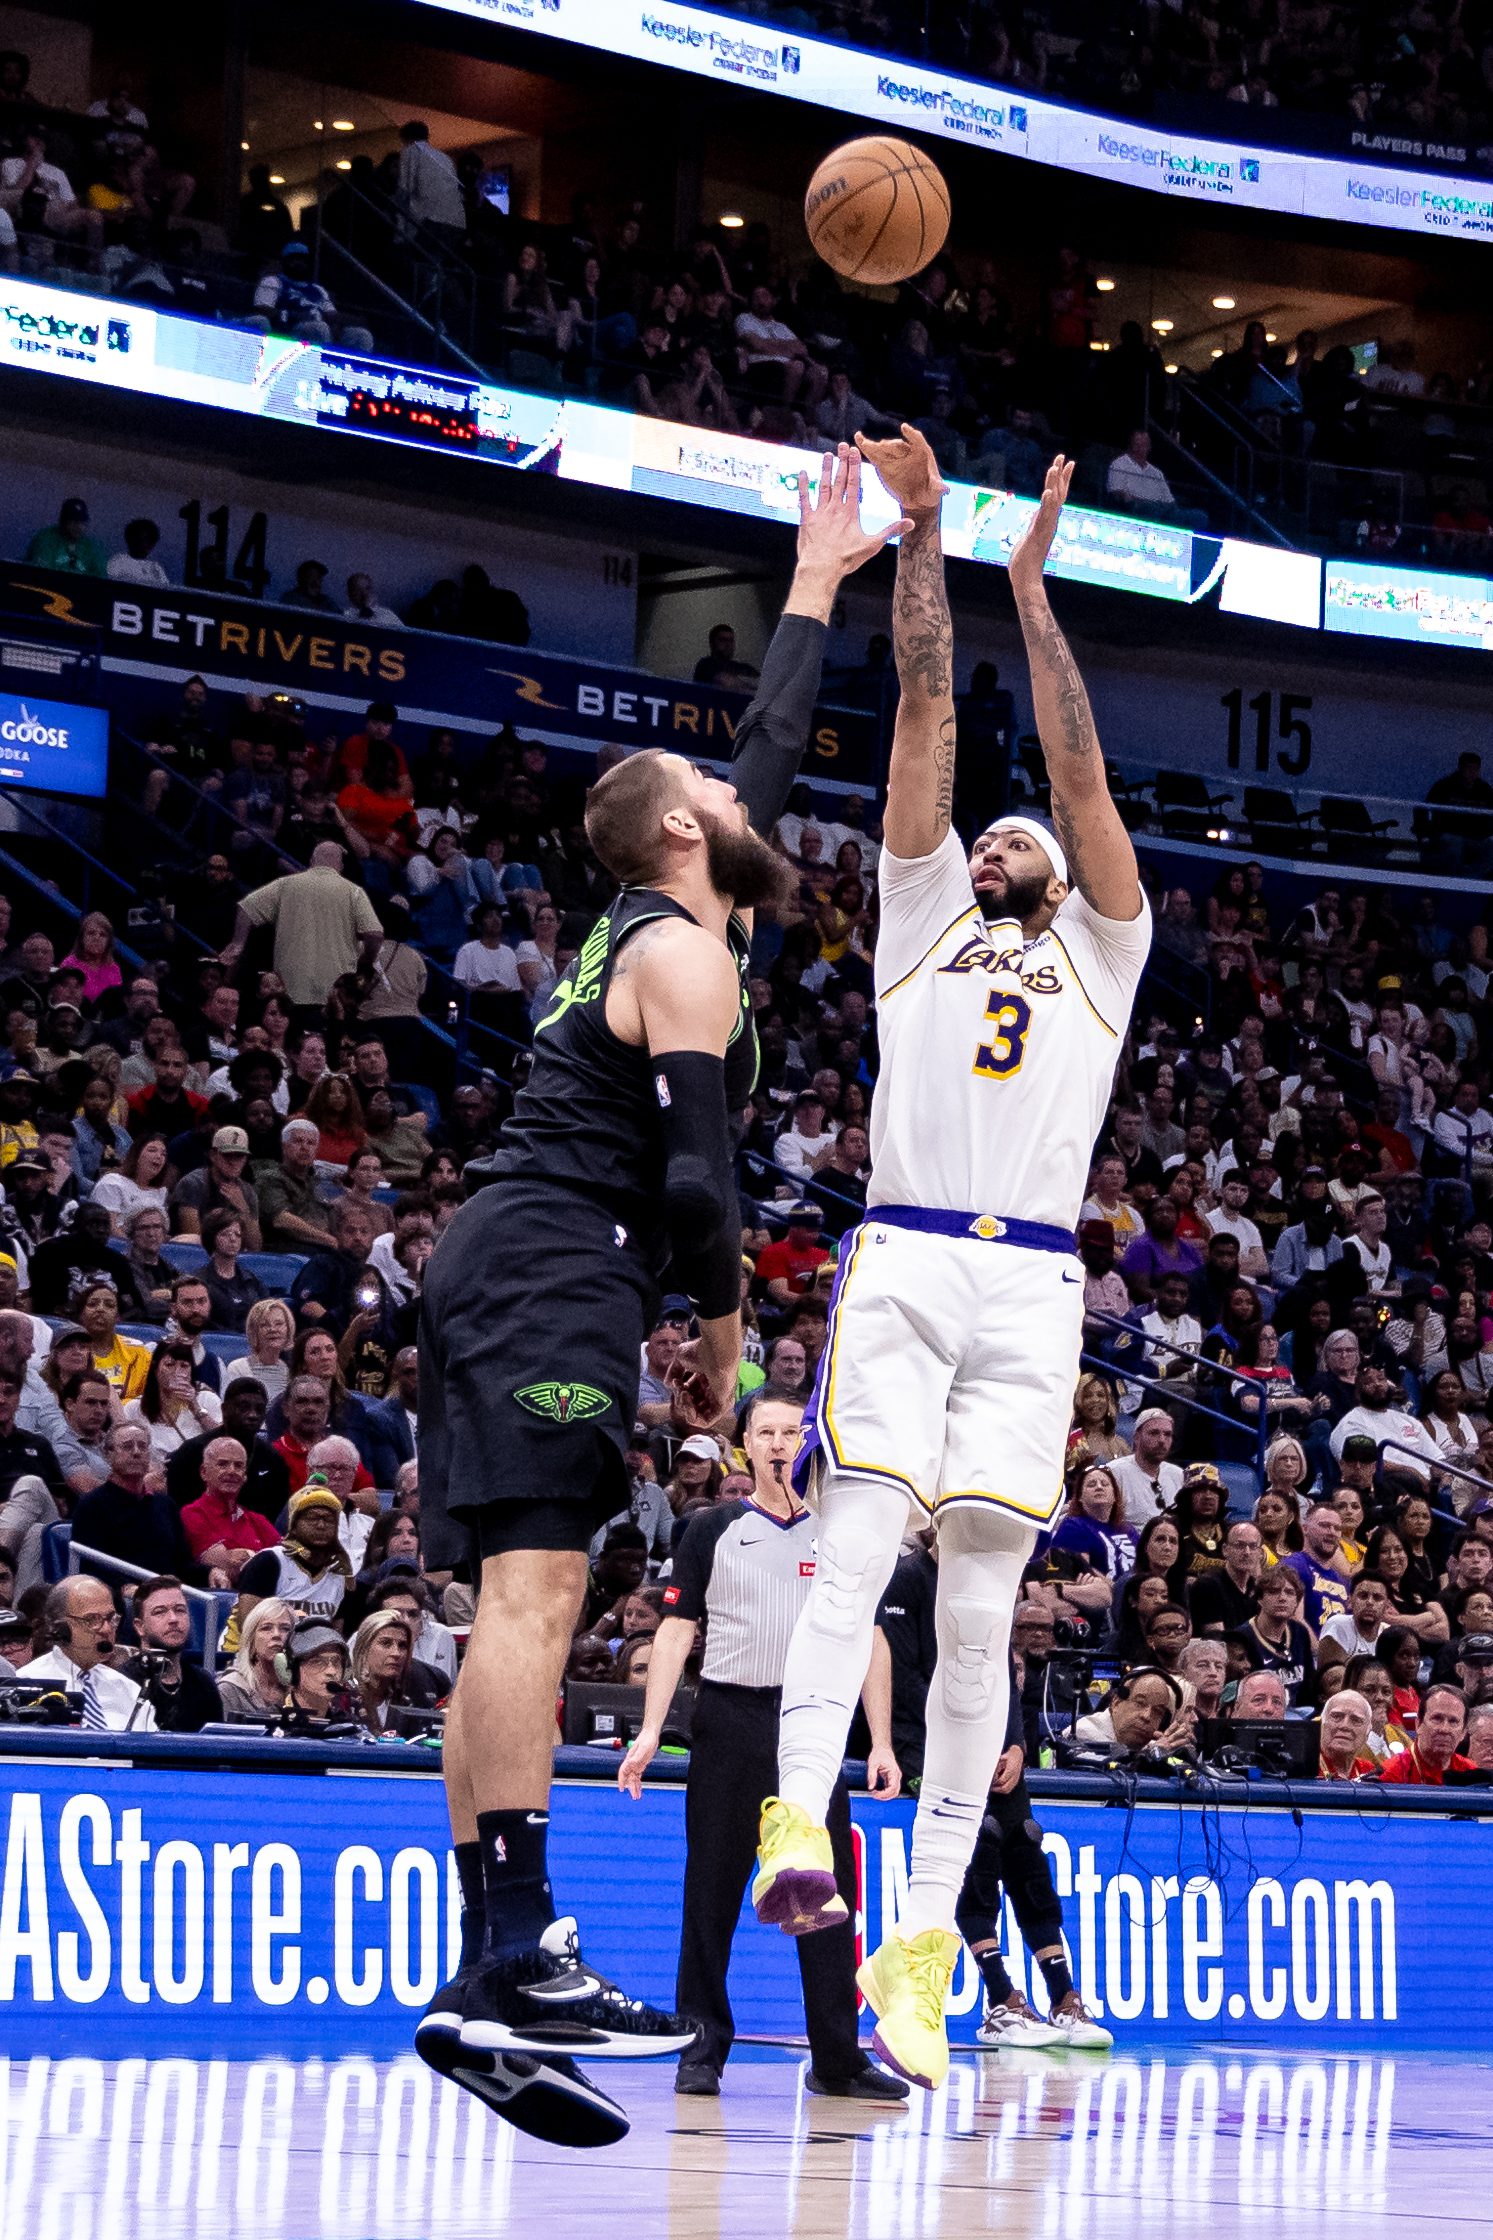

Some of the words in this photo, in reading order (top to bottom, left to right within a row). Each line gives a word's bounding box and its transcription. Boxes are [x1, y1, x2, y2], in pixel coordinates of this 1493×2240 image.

[1352, 131, 1423, 156] PLAYERS
[1426, 143, 1467, 162] PASS
[179, 499, 272, 599] 114
[111, 600, 406, 682] BETRIVERS
[1, 720, 69, 749] GOOSE
[1220, 688, 1313, 776] 115
[971, 987, 1034, 1082] 3
[0, 1792, 463, 2007] AStore.co
